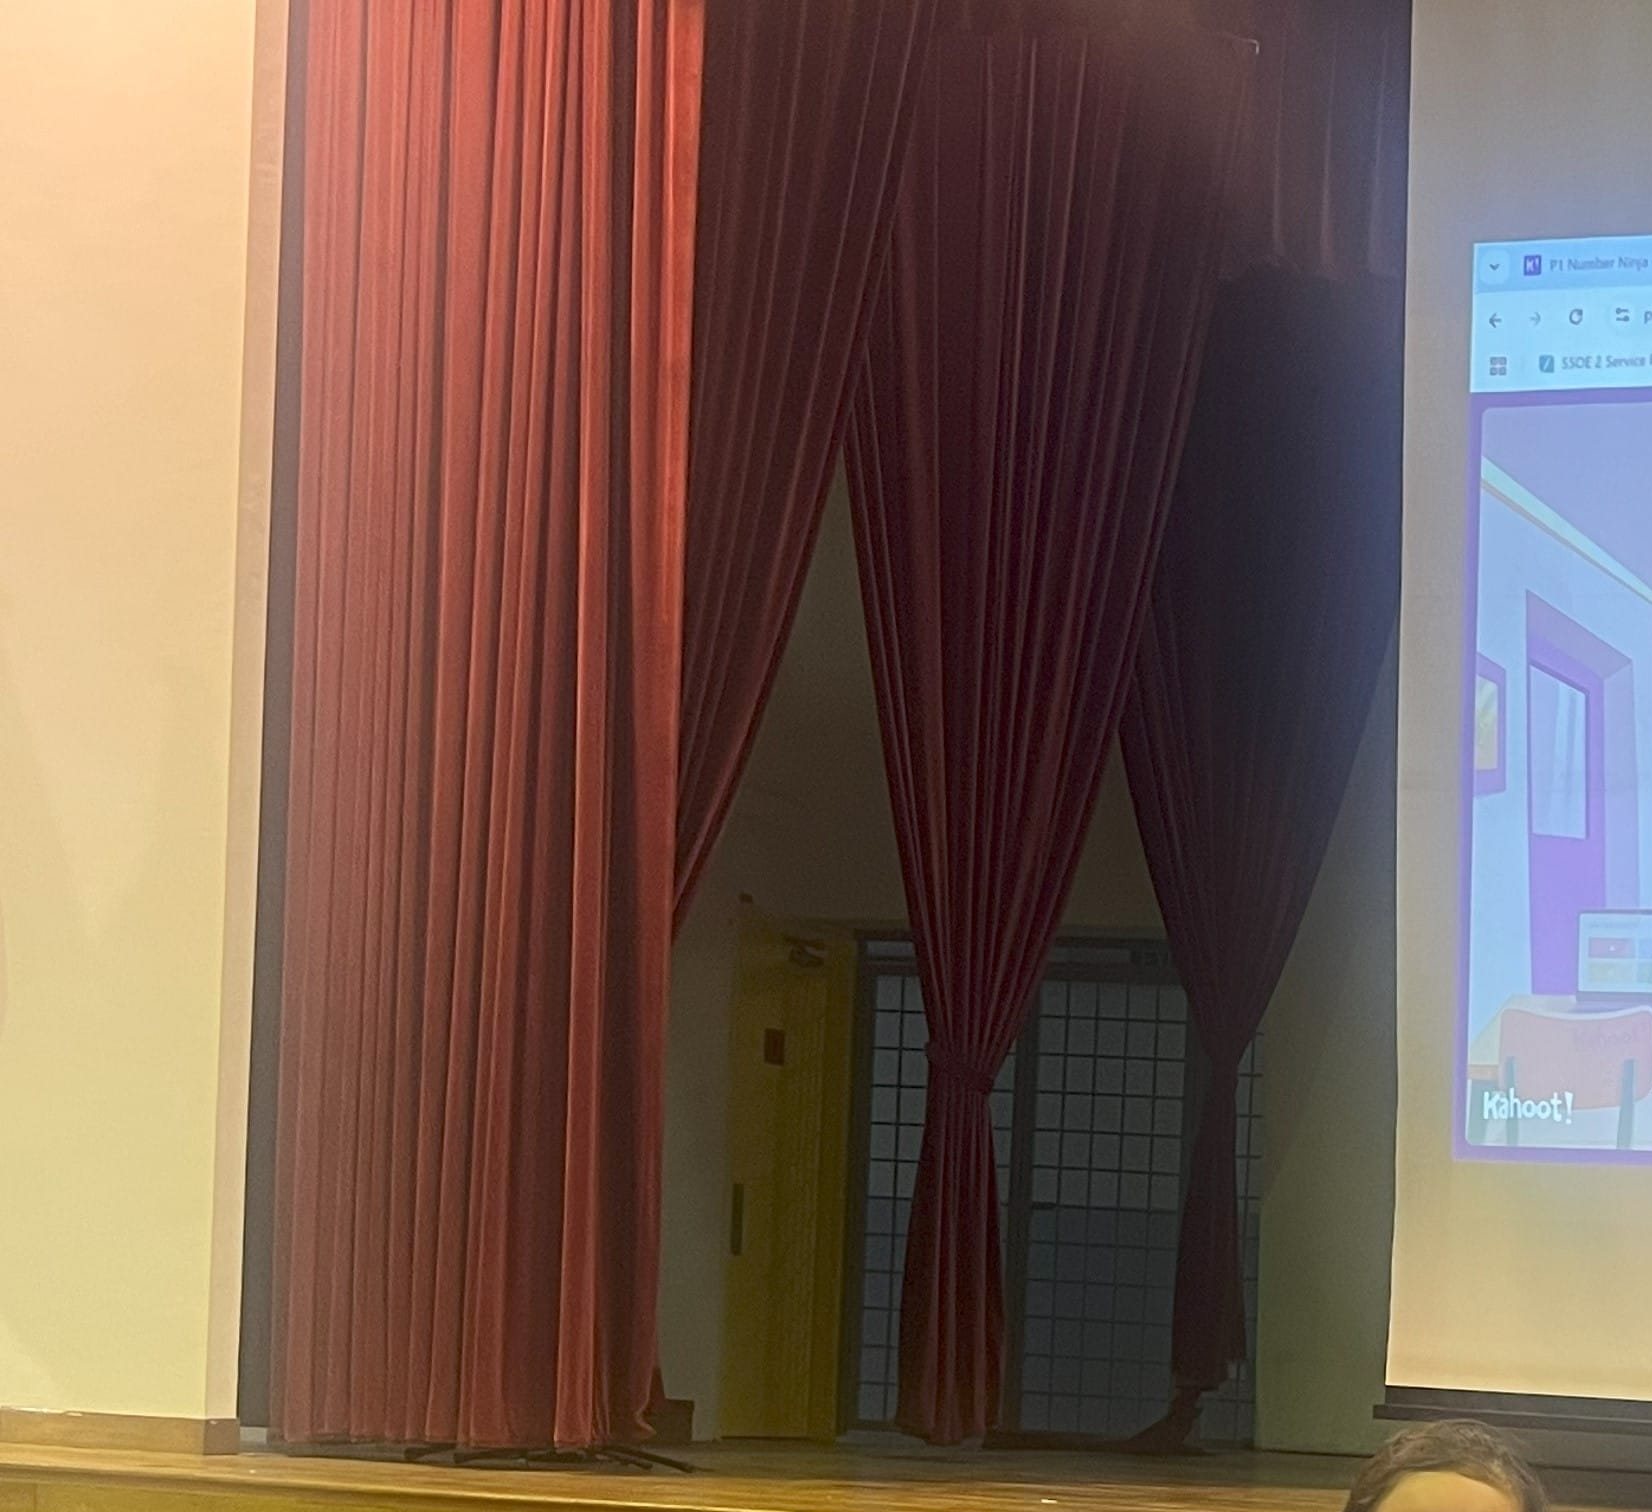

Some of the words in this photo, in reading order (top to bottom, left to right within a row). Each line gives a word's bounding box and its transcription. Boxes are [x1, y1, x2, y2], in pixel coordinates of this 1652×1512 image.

[1567, 257, 1615, 270] Number
[1618, 256, 1648, 270] Ninja
[1606, 353, 1646, 367] Service
[1483, 1088, 1573, 1124] Kahoot!
